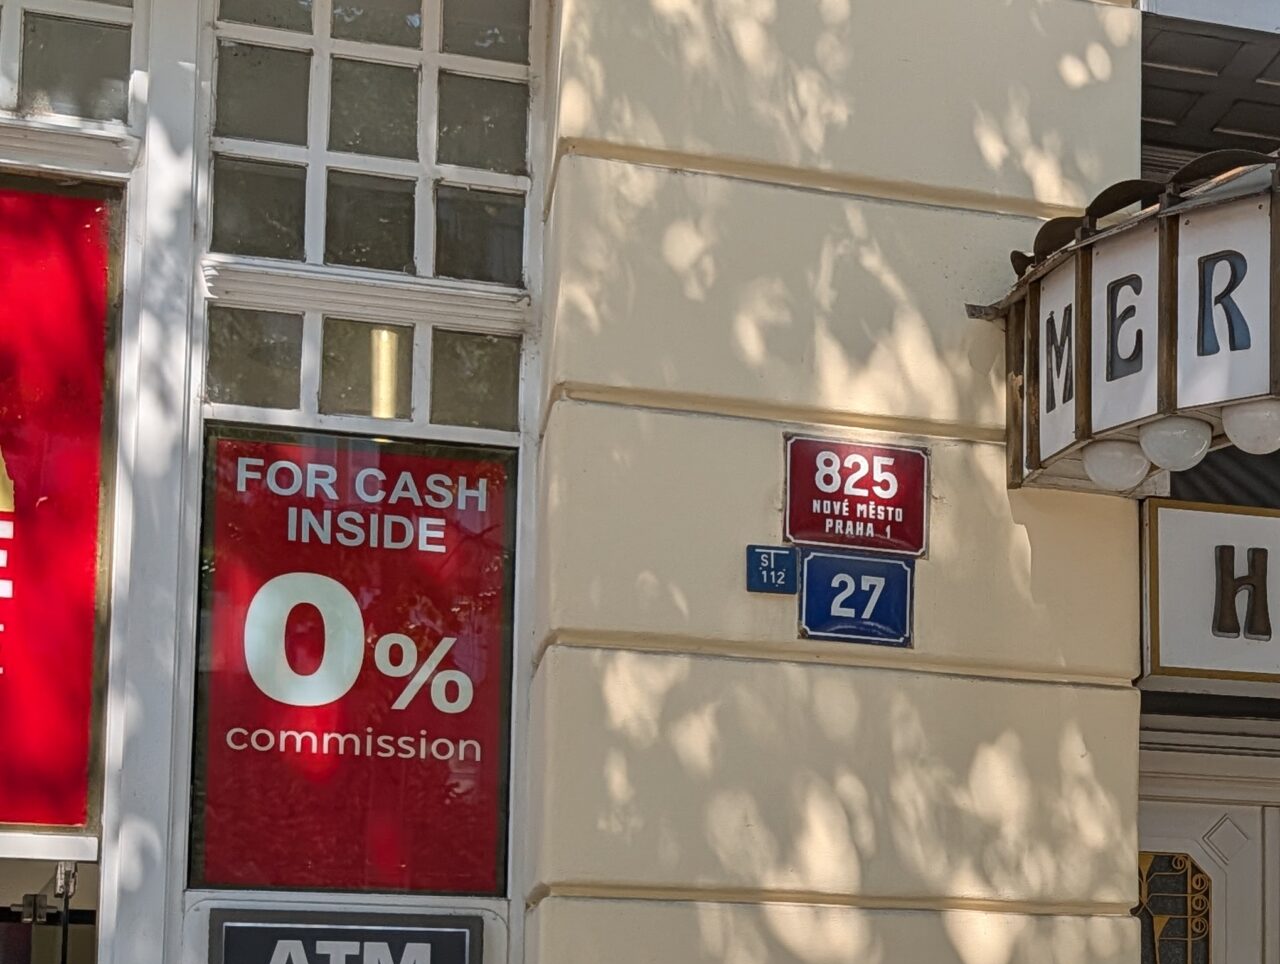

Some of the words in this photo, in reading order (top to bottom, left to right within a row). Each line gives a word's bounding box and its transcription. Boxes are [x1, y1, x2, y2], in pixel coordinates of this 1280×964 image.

[236, 457, 340, 501] FOR
[355, 467, 488, 512] CASH
[814, 450, 898, 499] 825
[287, 506, 447, 553] INSIDE
[812, 499, 850, 516] NOVÉ
[856, 501, 903, 522] MĚSTO
[825, 518, 875, 538] PRAHA
[885, 525, 891, 539] 1
[761, 570, 786, 585] 112
[830, 573, 886, 620] 27
[243, 571, 474, 713] 0%
[225, 726, 483, 763] commission
